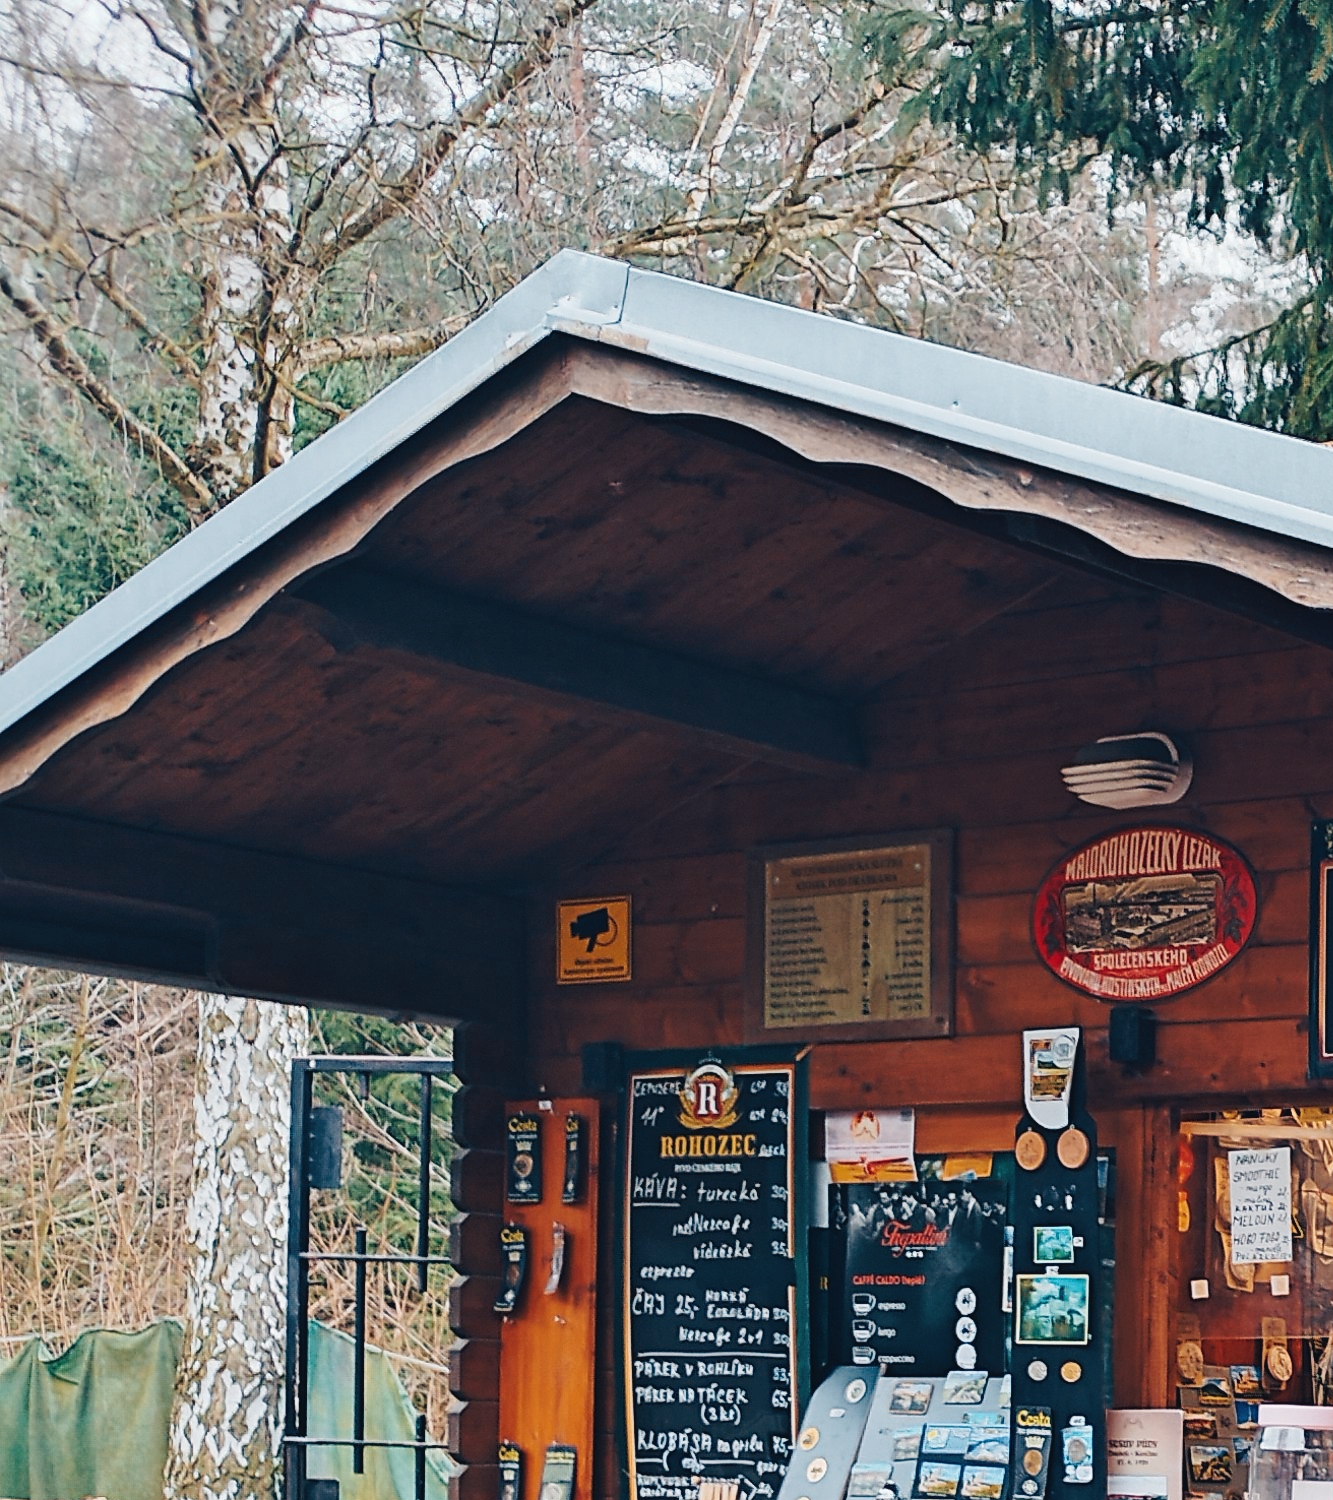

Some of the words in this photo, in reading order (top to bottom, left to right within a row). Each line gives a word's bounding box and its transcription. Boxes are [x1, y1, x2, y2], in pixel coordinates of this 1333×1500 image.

[660, 1133, 757, 1158] ROHOZEC
[1233, 1214, 1276, 1228] MELOUN
[632, 1287, 665, 1316] ČAJ
[633, 1359, 681, 1379] PÁREK
[697, 1358, 754, 1377] ROHLÍKU
[634, 1386, 676, 1404] PÁREK
[637, 1428, 713, 1454] KLOBÁSA
